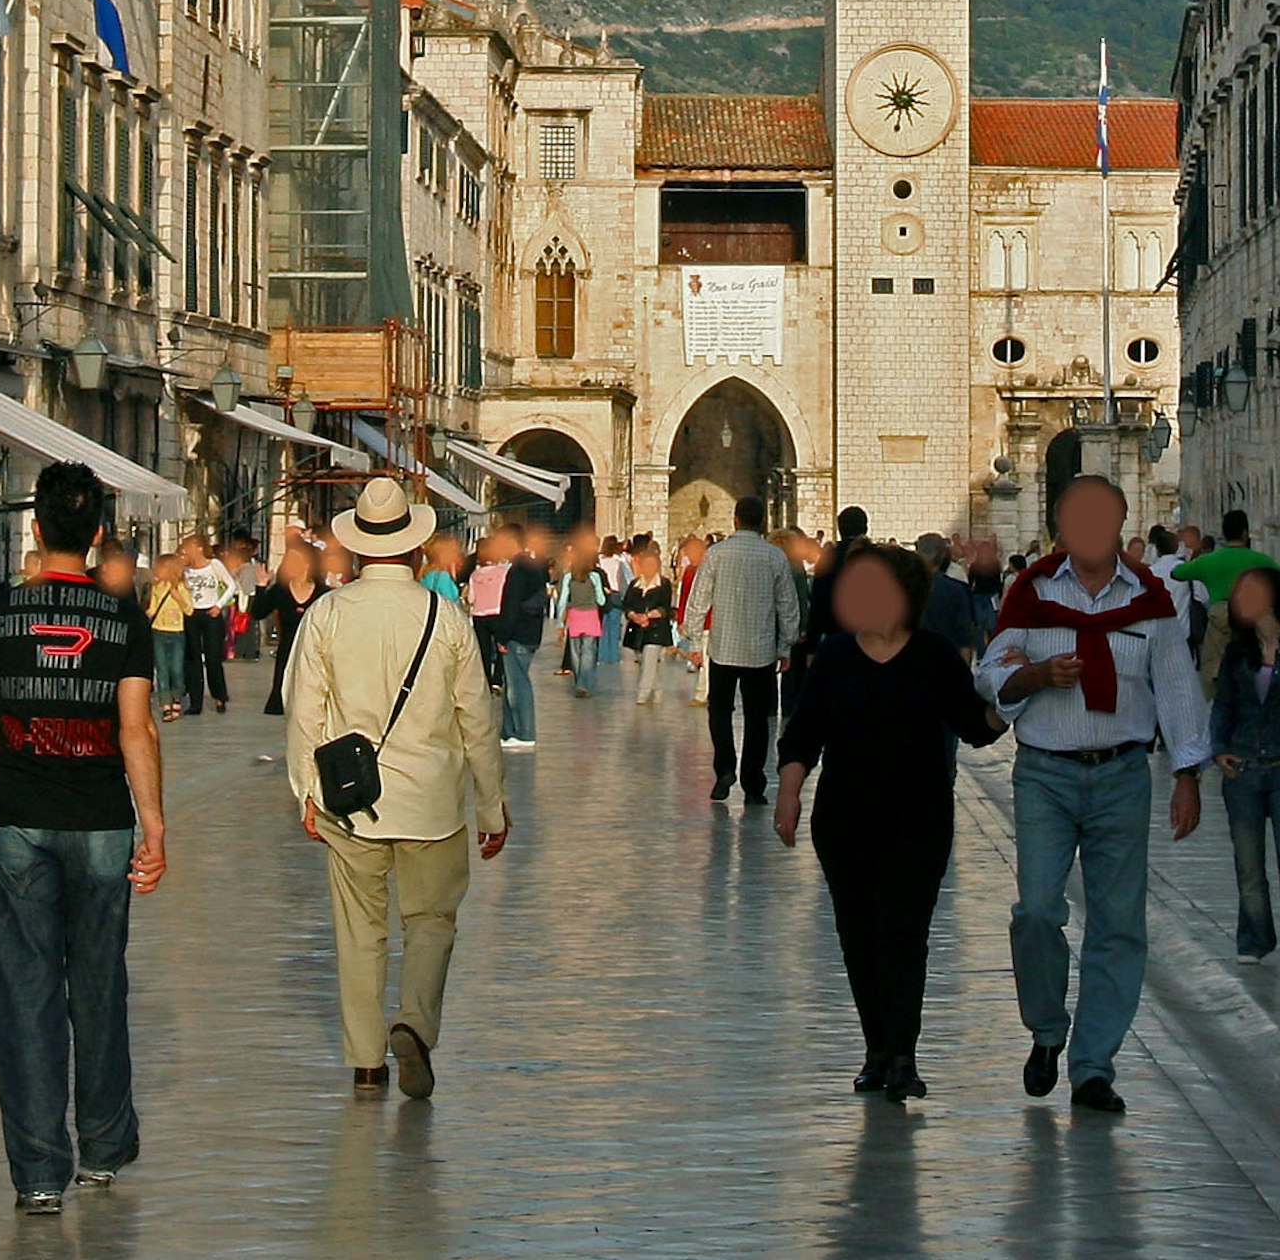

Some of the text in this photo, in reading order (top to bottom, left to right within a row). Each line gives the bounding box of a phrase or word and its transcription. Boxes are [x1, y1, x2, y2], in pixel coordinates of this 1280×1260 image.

[9, 585, 119, 613] DIESEL FABRICS
[85, 616, 128, 645] DENIM
[0, 676, 116, 703] MECHANICAL WEFT
